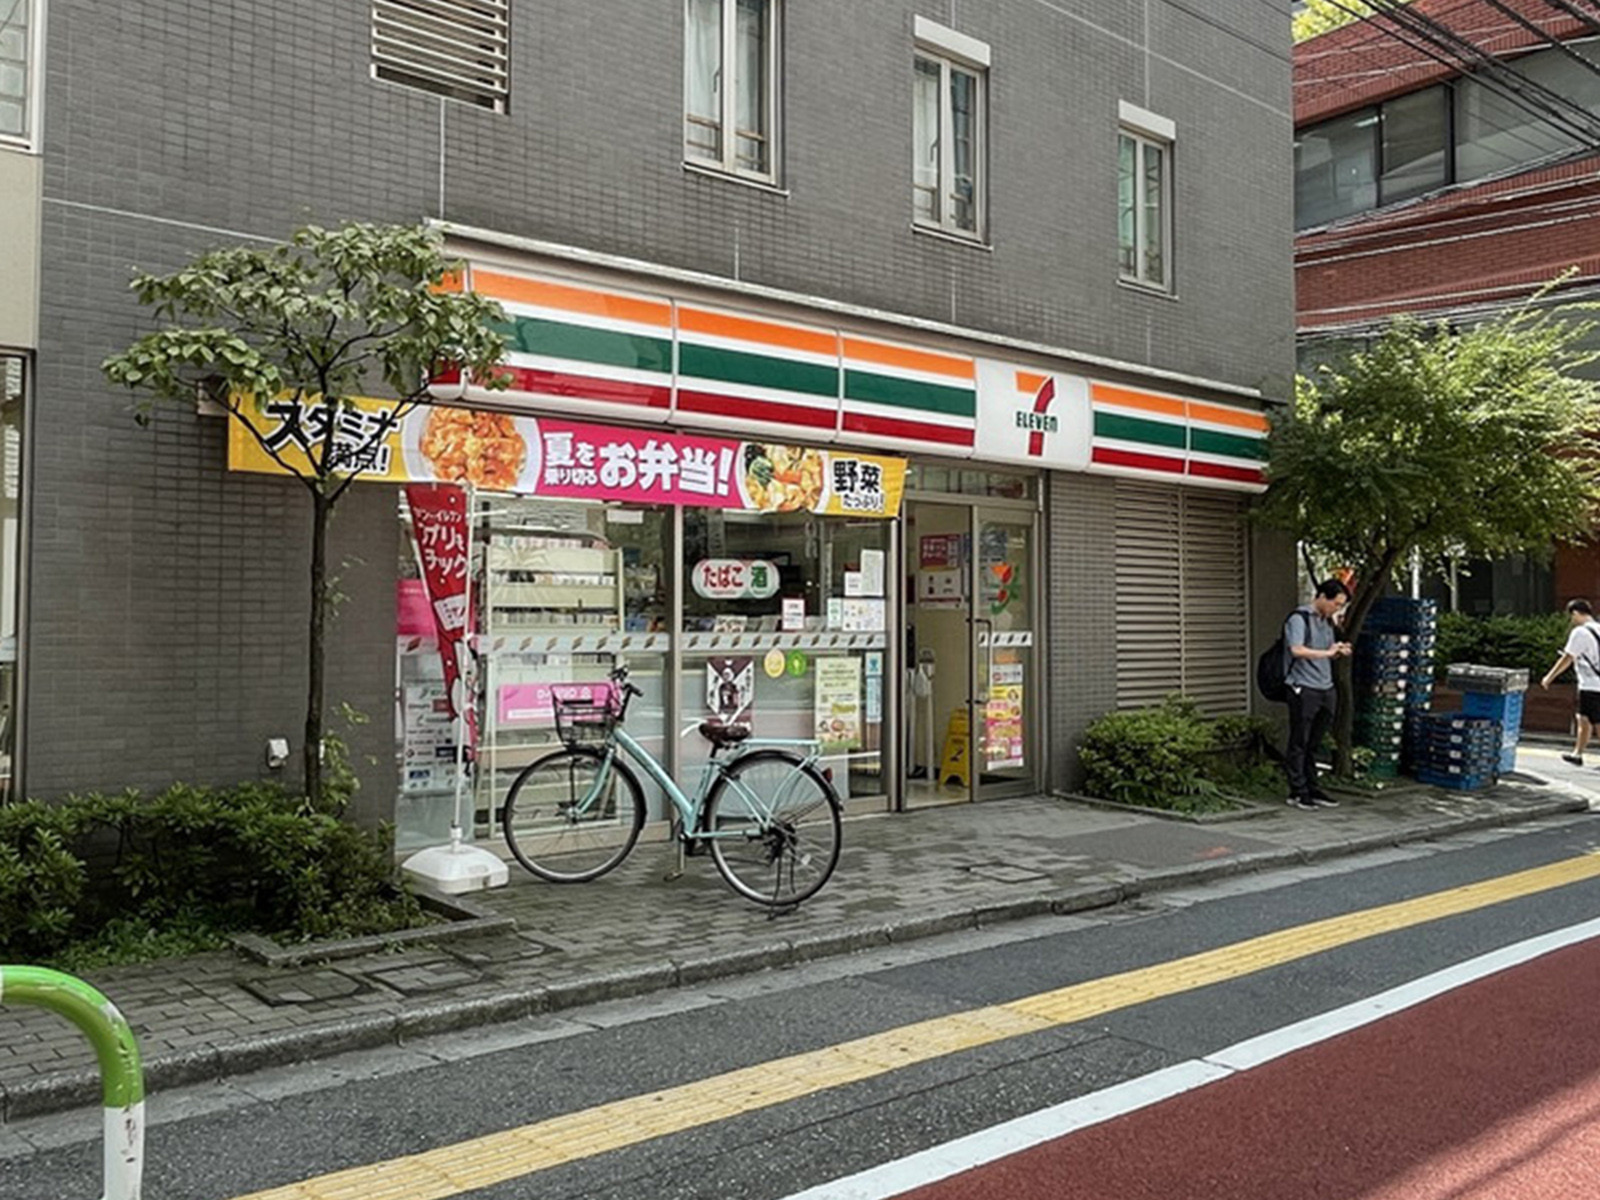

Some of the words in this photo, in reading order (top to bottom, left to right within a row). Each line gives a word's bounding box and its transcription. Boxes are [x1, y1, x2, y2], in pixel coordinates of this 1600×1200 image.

[263, 401, 398, 452] スタミナ
[543, 432, 597, 467] 夏を
[599, 439, 734, 497] お弁当!
[833, 461, 881, 493] 野菜
[703, 566, 744, 588] たばこ
[750, 566, 768, 588] 酒
